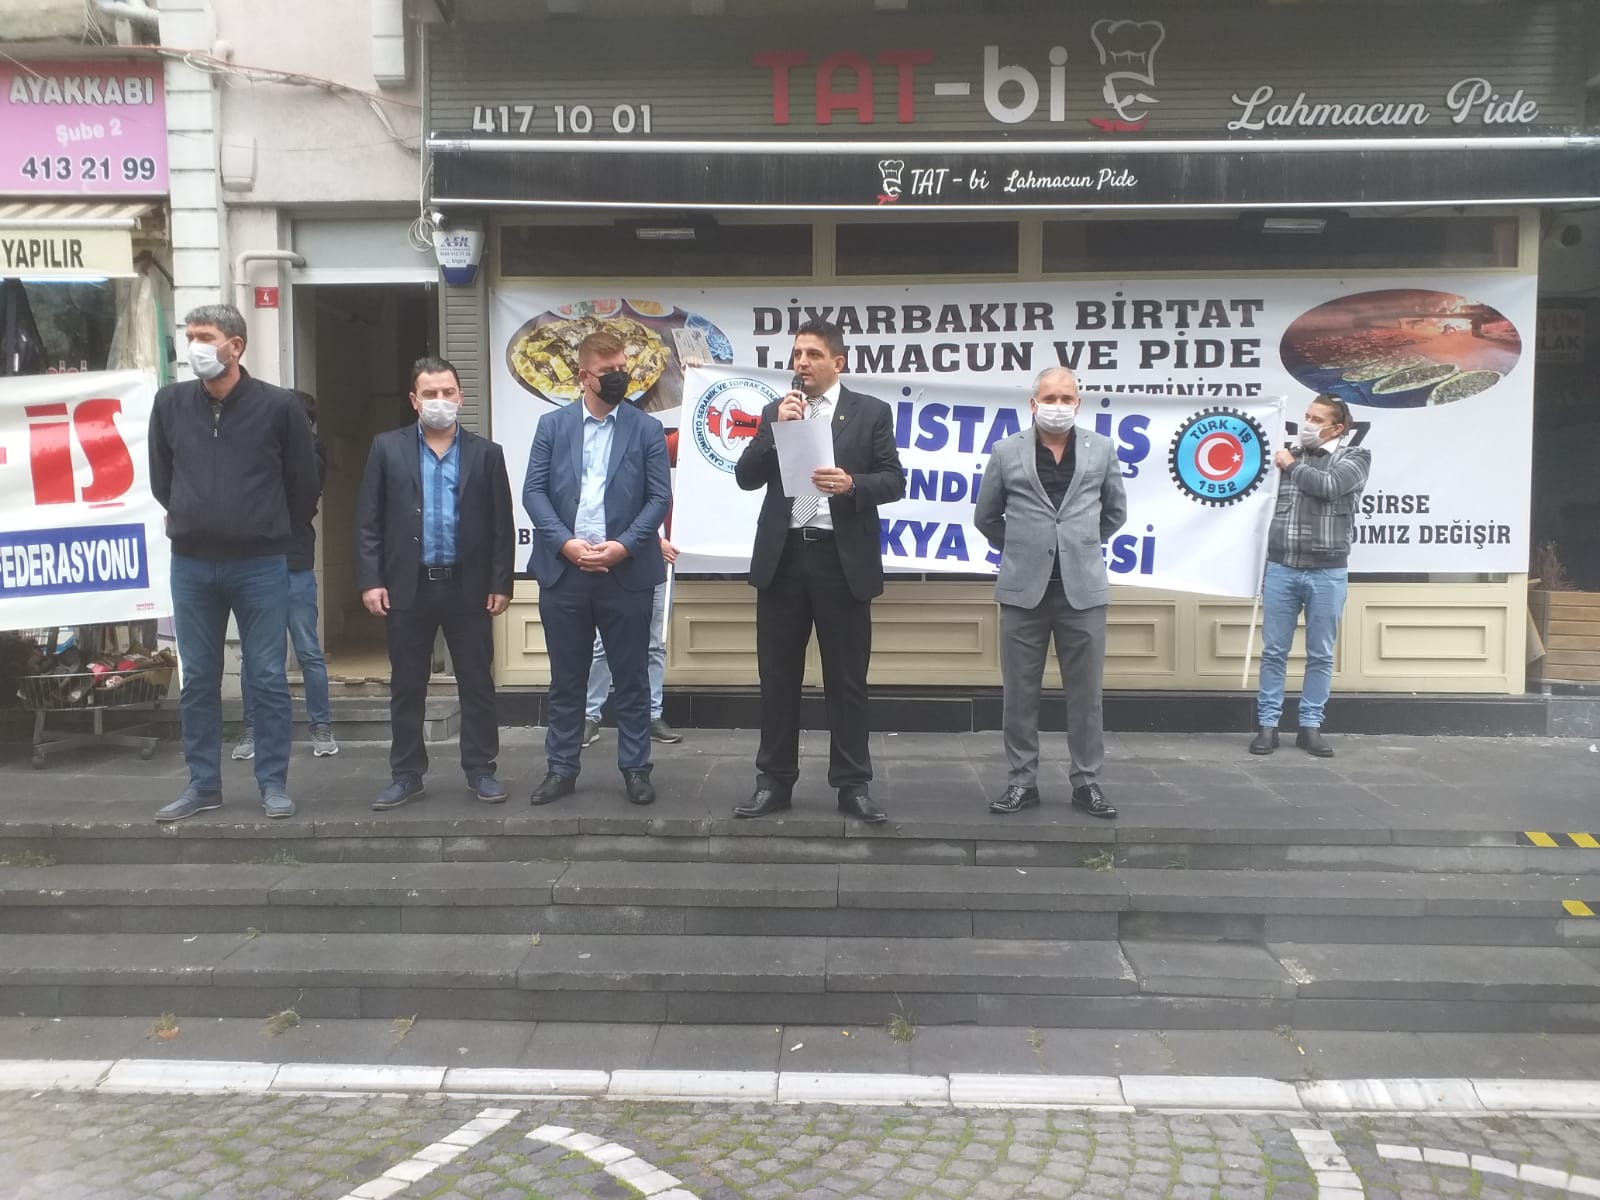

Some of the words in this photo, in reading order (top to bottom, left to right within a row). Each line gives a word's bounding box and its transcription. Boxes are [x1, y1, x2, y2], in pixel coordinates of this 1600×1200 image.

[9, 76, 154, 104] AYAKKABI
[1227, 85, 1430, 130] Lahmacun
[1446, 77, 1539, 124] Pide
[56, 122, 104, 147] Şube
[109, 117, 122, 136] 2
[472, 105, 534, 133] 417
[554, 105, 593, 133] 10
[612, 104, 651, 133] 01
[22, 156, 71, 180] 413
[81, 156, 110, 180] 21
[122, 156, 155, 180] 99
[1004, 170, 1094, 192] Lahmacun
[1096, 168, 1138, 190] Pide
[2, 239, 84, 268] YAPILIR
[753, 298, 1054, 335] DİYARBAKIR
[1075, 291, 1264, 330] BİRTAT
[756, 342, 1034, 374] LMACUN
[1053, 340, 1118, 370] VE
[1139, 331, 1262, 370] PİDE
[1189, 418, 1229, 440] TÜRK
[1199, 480, 1237, 494] 1952
[1352, 490, 1430, 519] ŞİRSE
[880, 518, 970, 561] KYA
[1351, 526, 1410, 544] IMIZ
[1419, 520, 1511, 549] DEĞİŞİR
[0, 538, 139, 588] EDERASYONU
